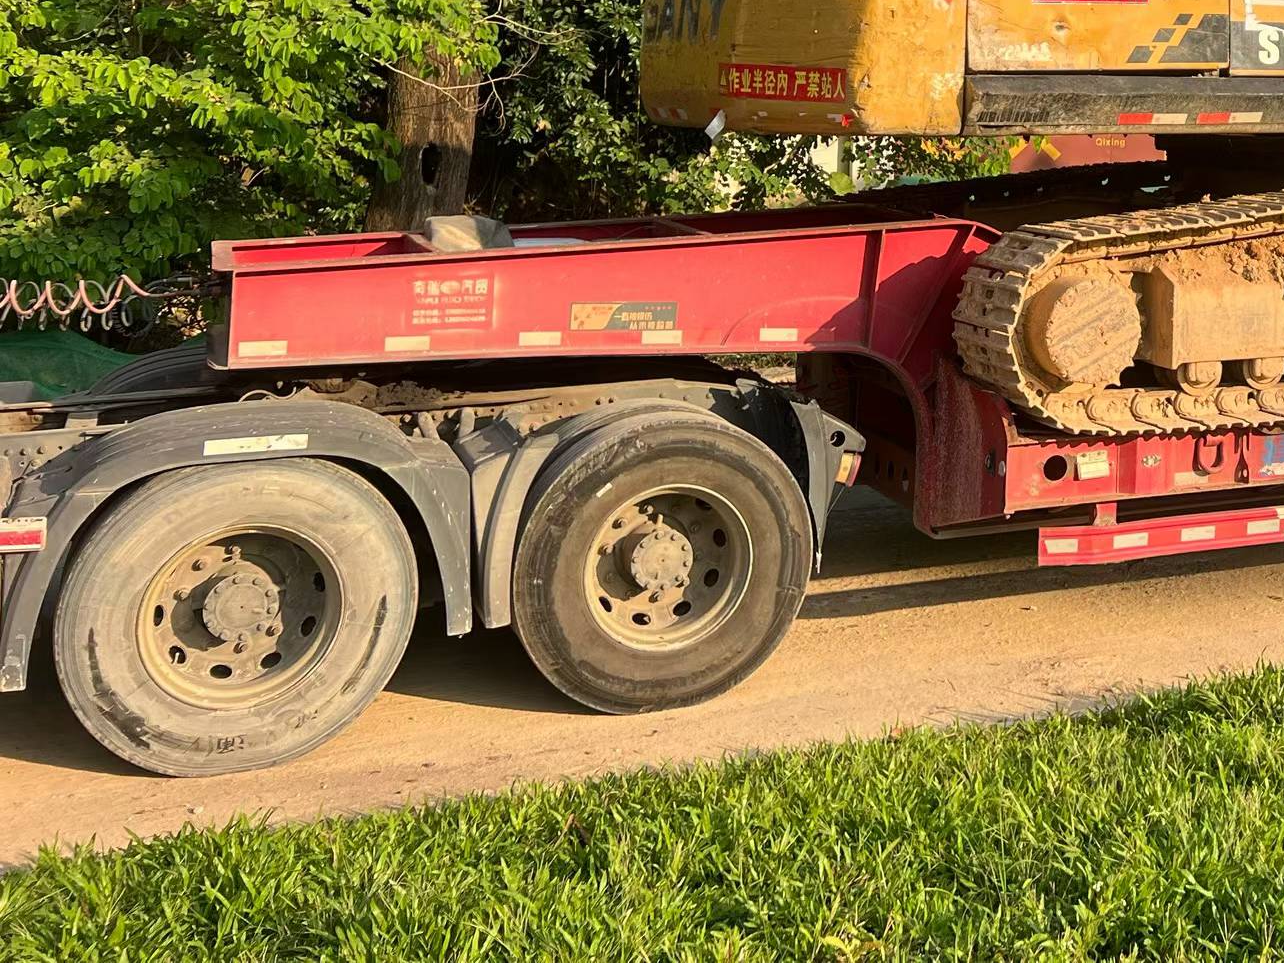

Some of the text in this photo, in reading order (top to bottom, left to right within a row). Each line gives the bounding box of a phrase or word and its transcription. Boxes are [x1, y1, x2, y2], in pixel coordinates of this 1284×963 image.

[728, 68, 846, 99] 作业半径内 严禁站人
[1095, 138, 1126, 149] Qixing
